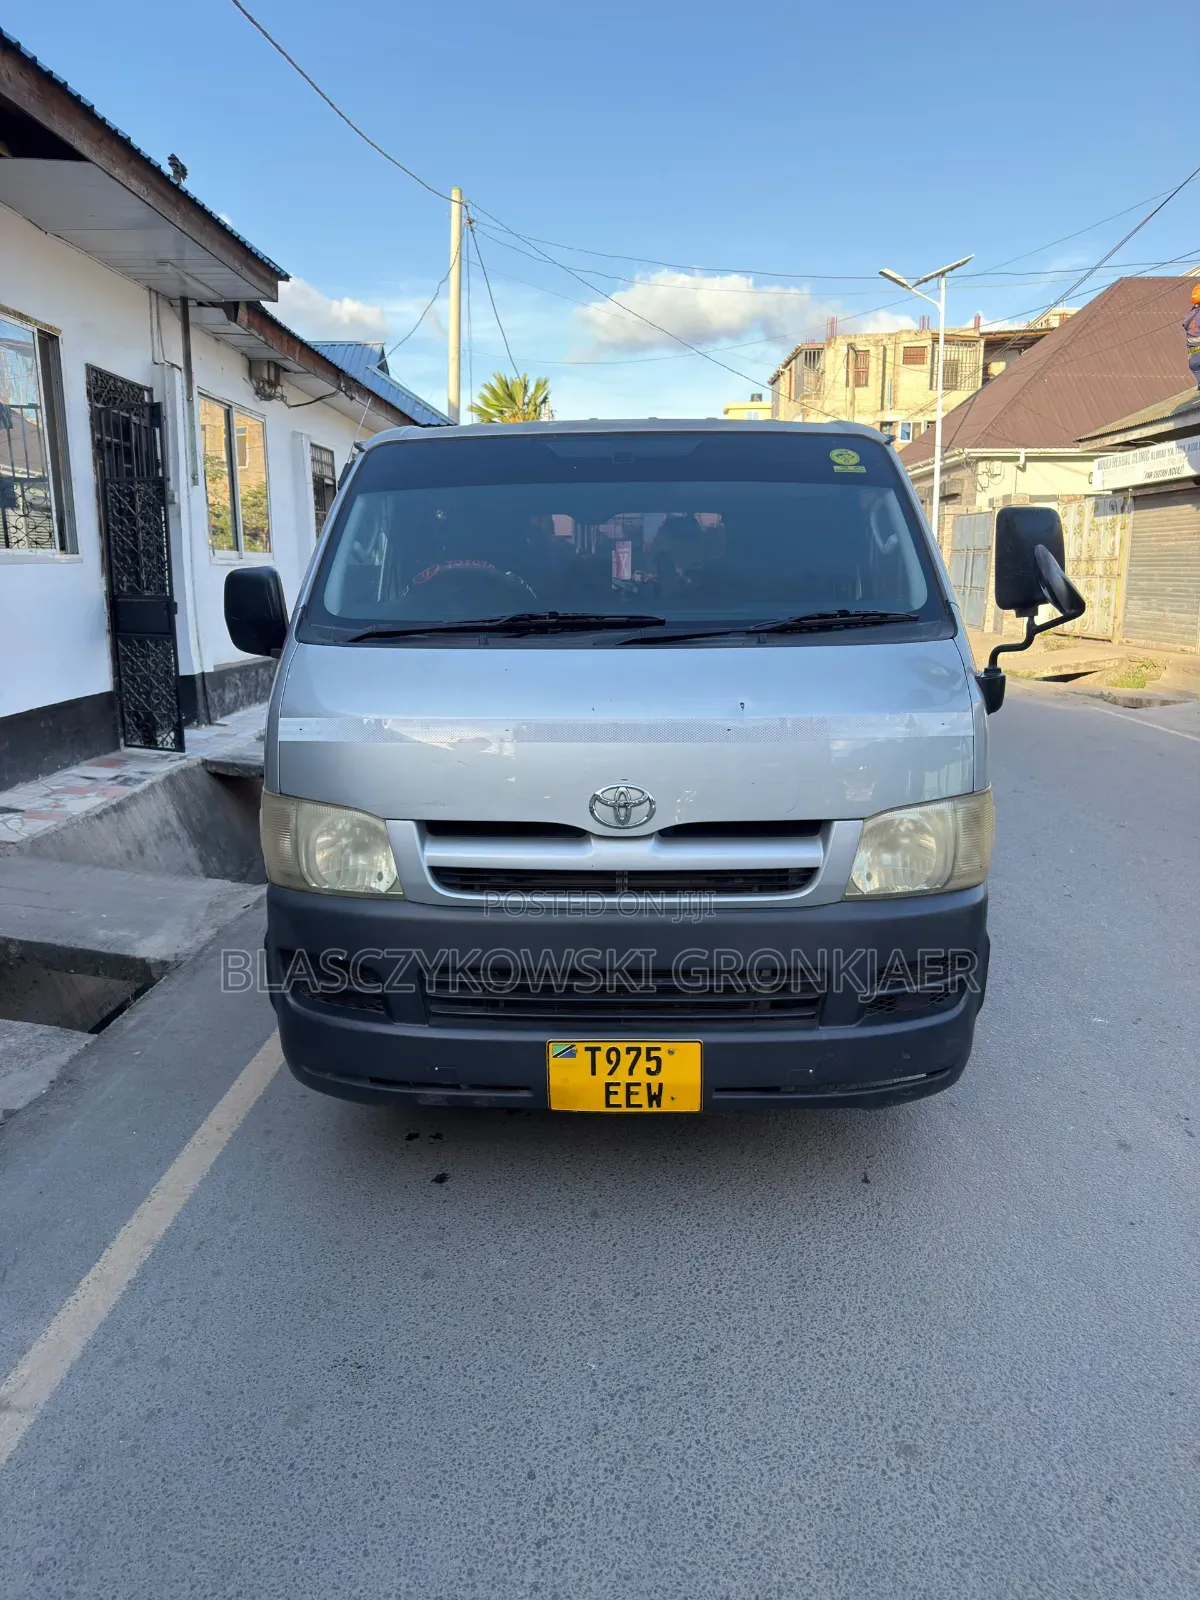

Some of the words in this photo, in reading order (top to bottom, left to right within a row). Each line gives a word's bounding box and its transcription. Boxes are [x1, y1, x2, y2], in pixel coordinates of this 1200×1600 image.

[1112, 454, 1131, 468] HERBAL
[1132, 449, 1150, 464] CLINIC
[446, 559, 495, 570] TOYOTA
[584, 1046, 663, 1076] T975
[604, 1081, 664, 1108] EEW
